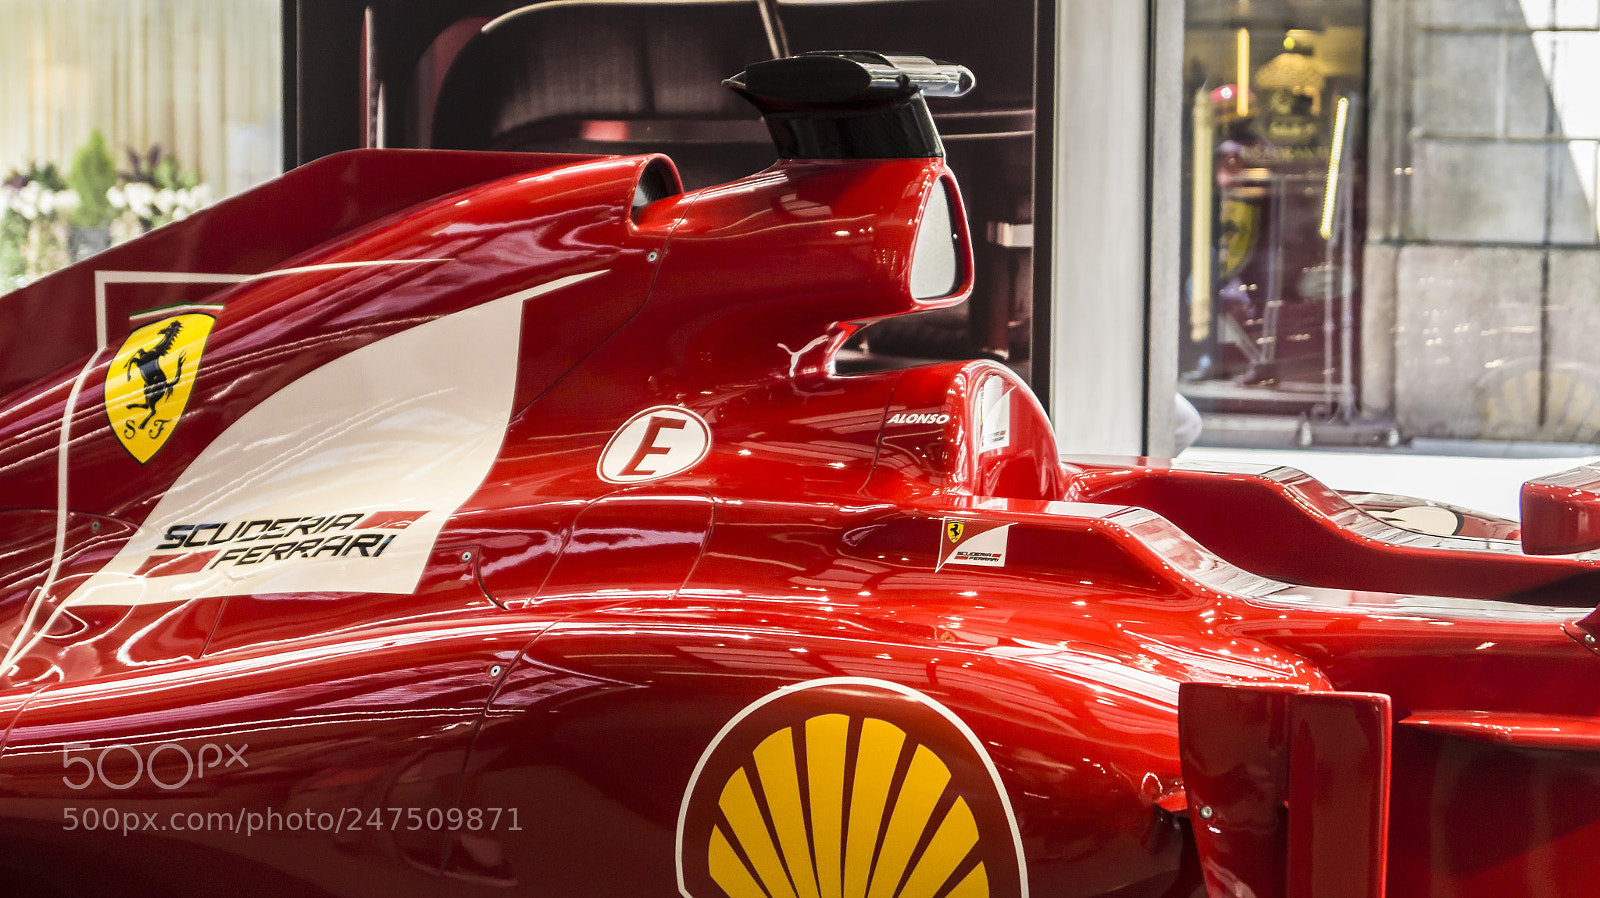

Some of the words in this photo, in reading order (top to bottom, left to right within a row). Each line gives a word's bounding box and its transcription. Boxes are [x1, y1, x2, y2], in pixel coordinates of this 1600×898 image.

[123, 419, 136, 440] S
[148, 418, 172, 440] F
[887, 413, 950, 425] ALONSO
[617, 416, 686, 476] E
[156, 513, 365, 550] SCUDERIA
[209, 534, 397, 570] FERRARI
